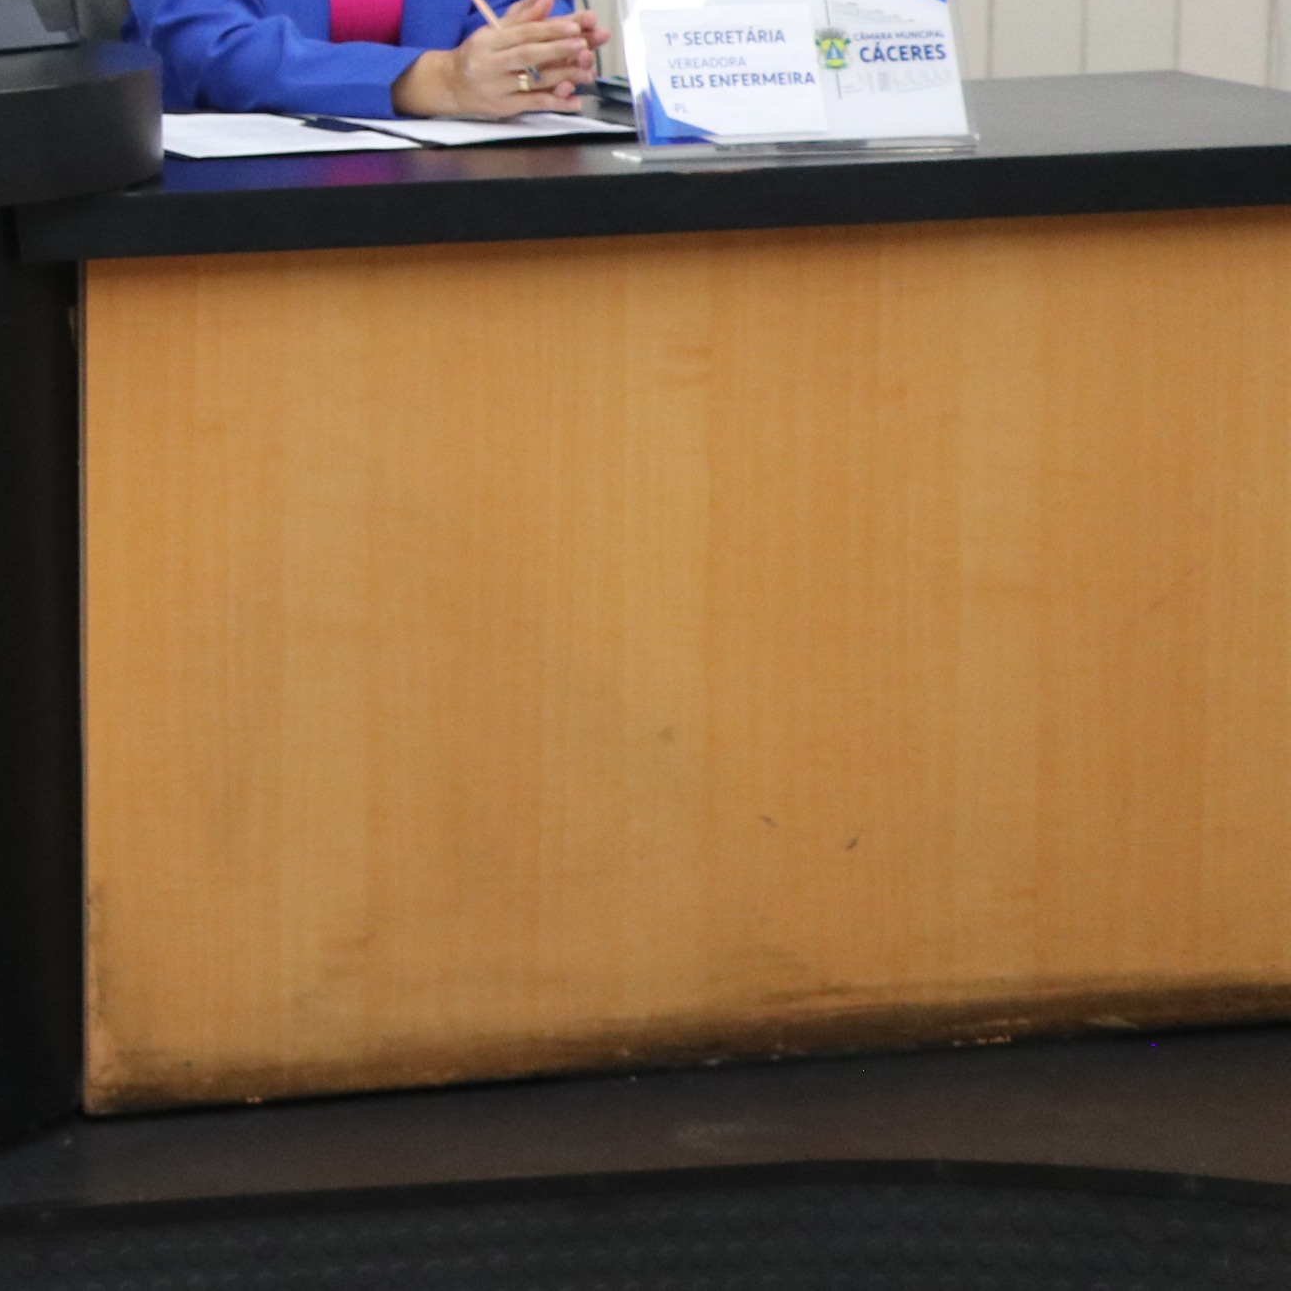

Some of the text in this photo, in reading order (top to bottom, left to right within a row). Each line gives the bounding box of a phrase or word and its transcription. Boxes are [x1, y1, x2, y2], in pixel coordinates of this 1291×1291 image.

[683, 26, 786, 46] SECRETÁRIA
[854, 30, 946, 41] CÂMARA MUNICIPAL
[859, 41, 947, 63] CÁCERES
[668, 56, 747, 70] VEREADORA
[671, 72, 816, 89] ELIS ENFERMEIRA
